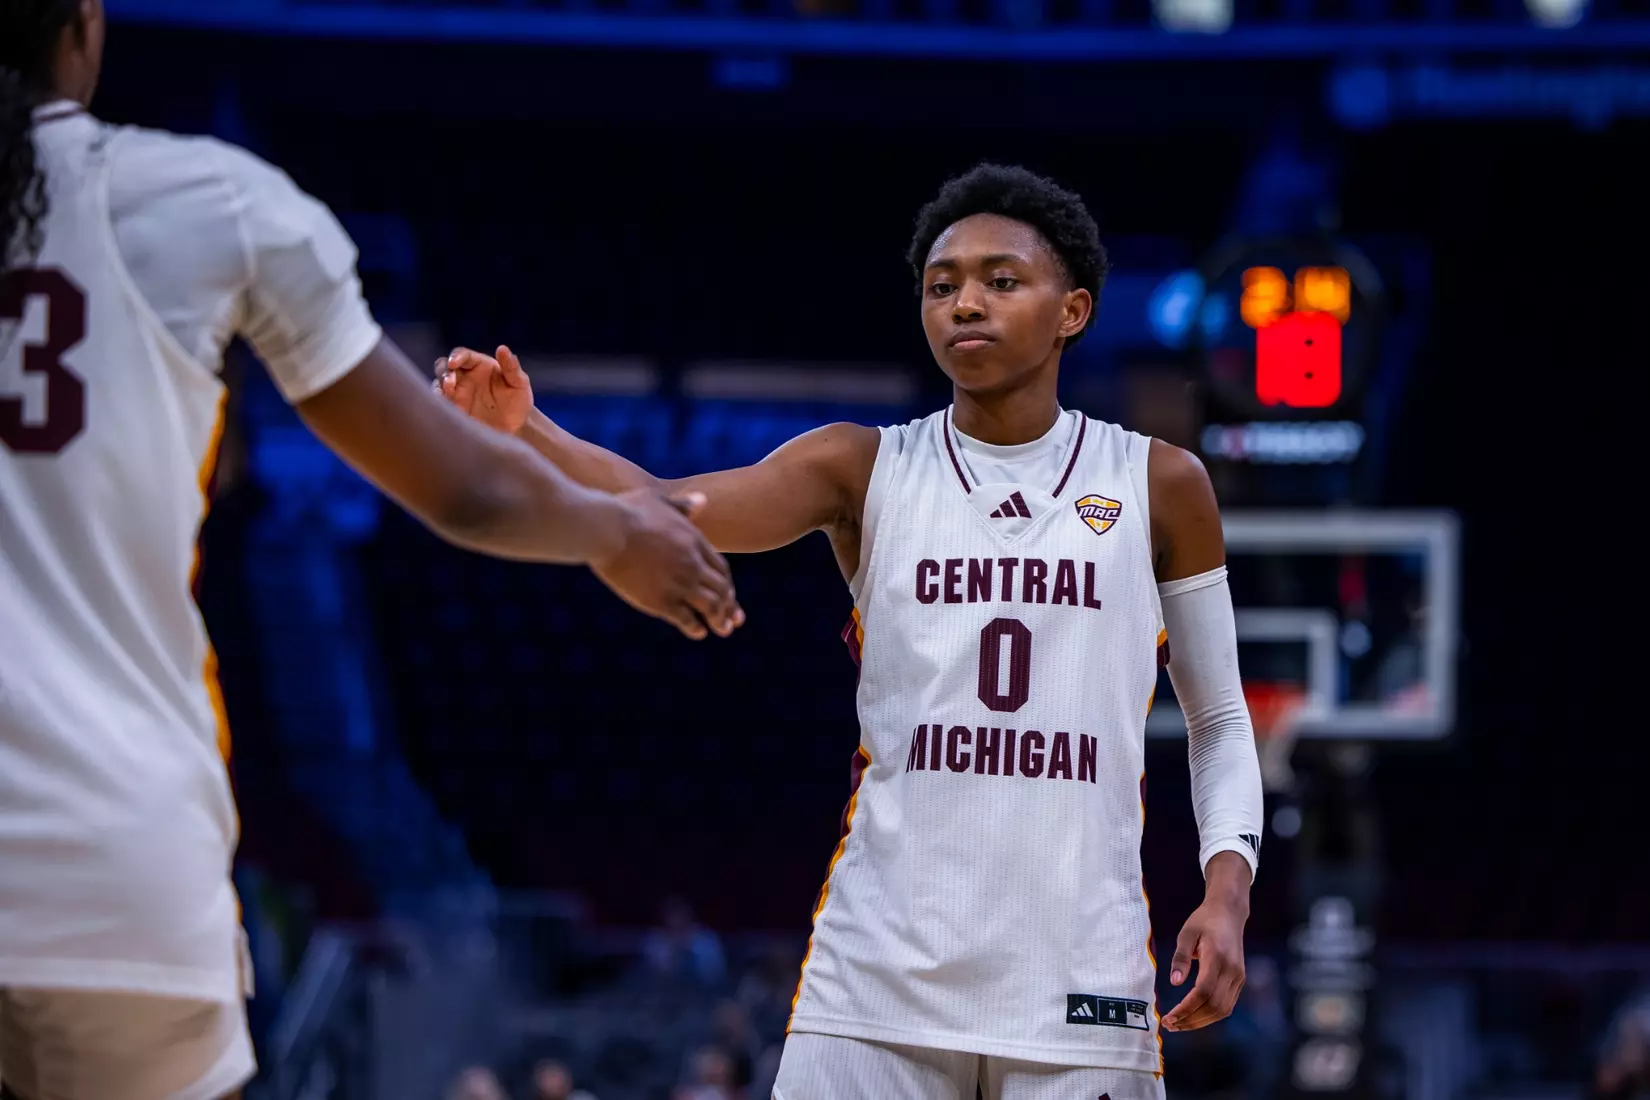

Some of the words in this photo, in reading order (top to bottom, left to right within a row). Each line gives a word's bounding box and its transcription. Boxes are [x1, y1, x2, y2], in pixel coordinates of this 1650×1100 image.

[0, 267, 87, 454] 3
[1078, 506, 1120, 519] MAC
[915, 557, 1102, 610] CENTRAL
[979, 617, 1032, 713] 0
[906, 723, 1098, 784] MICHIGAN
[1108, 1009, 1116, 1019] M
